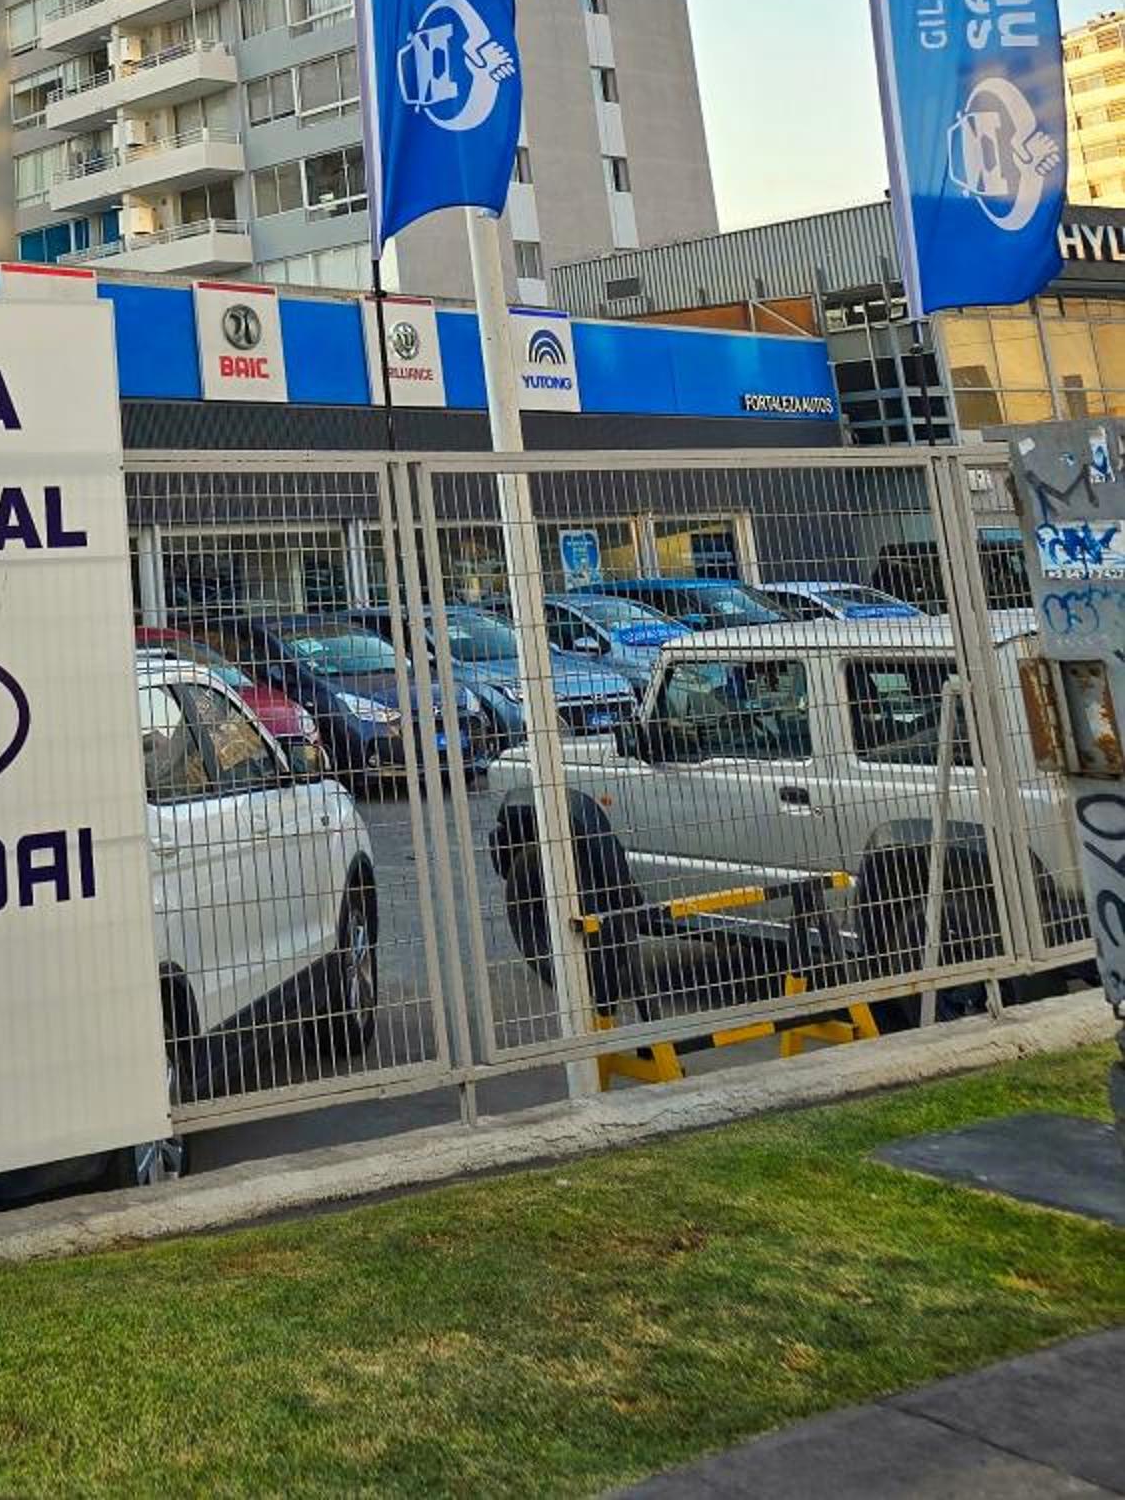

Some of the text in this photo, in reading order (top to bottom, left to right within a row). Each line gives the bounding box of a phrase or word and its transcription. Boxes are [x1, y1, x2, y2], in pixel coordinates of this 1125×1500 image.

[218, 355, 270, 380] BAIC
[522, 374, 572, 391] YUTONG
[744, 393, 834, 415] FORTALEZA AUTOS
